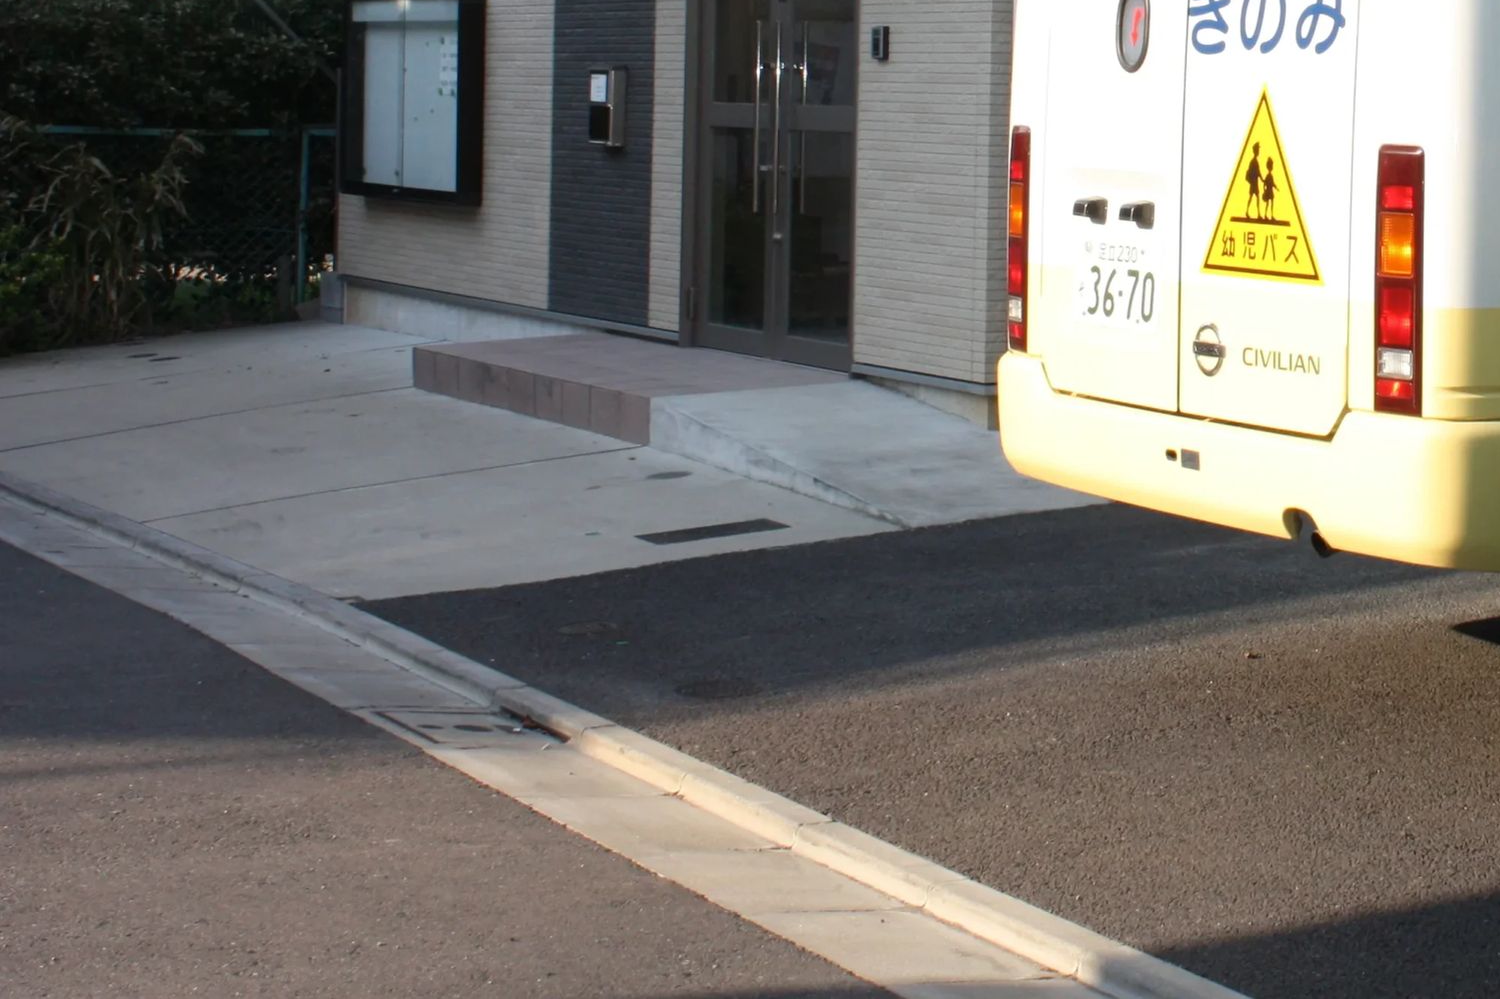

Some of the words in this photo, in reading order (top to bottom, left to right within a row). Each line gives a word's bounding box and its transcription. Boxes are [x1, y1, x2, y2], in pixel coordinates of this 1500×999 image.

[1222, 230, 1300, 264] 幼児バス
[1242, 347, 1320, 375] CIVILIAN
